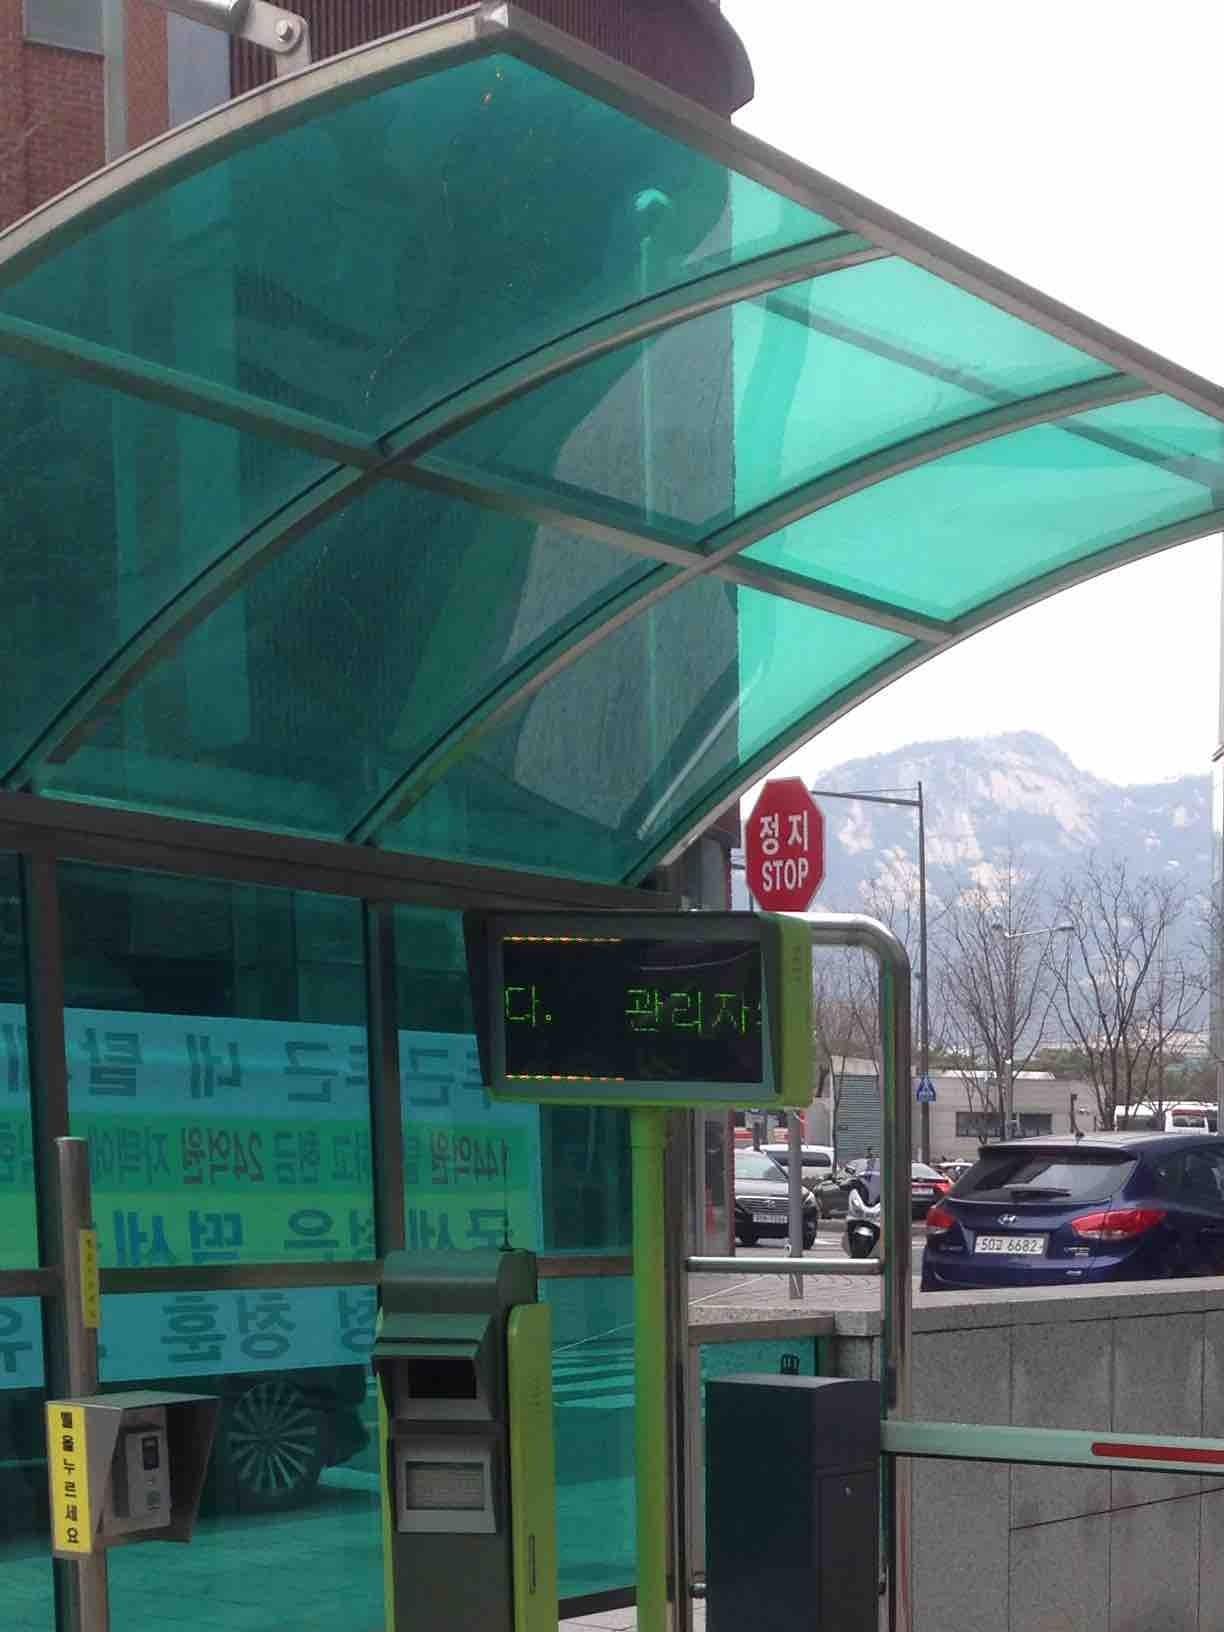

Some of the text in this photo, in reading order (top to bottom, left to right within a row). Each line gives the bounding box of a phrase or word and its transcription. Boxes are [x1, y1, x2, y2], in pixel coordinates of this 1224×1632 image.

[760, 811, 808, 855] 정지
[762, 857, 809, 892] STOP
[624, 988, 762, 1034] 관리자
[1007, 1240, 1040, 1252] 6682
